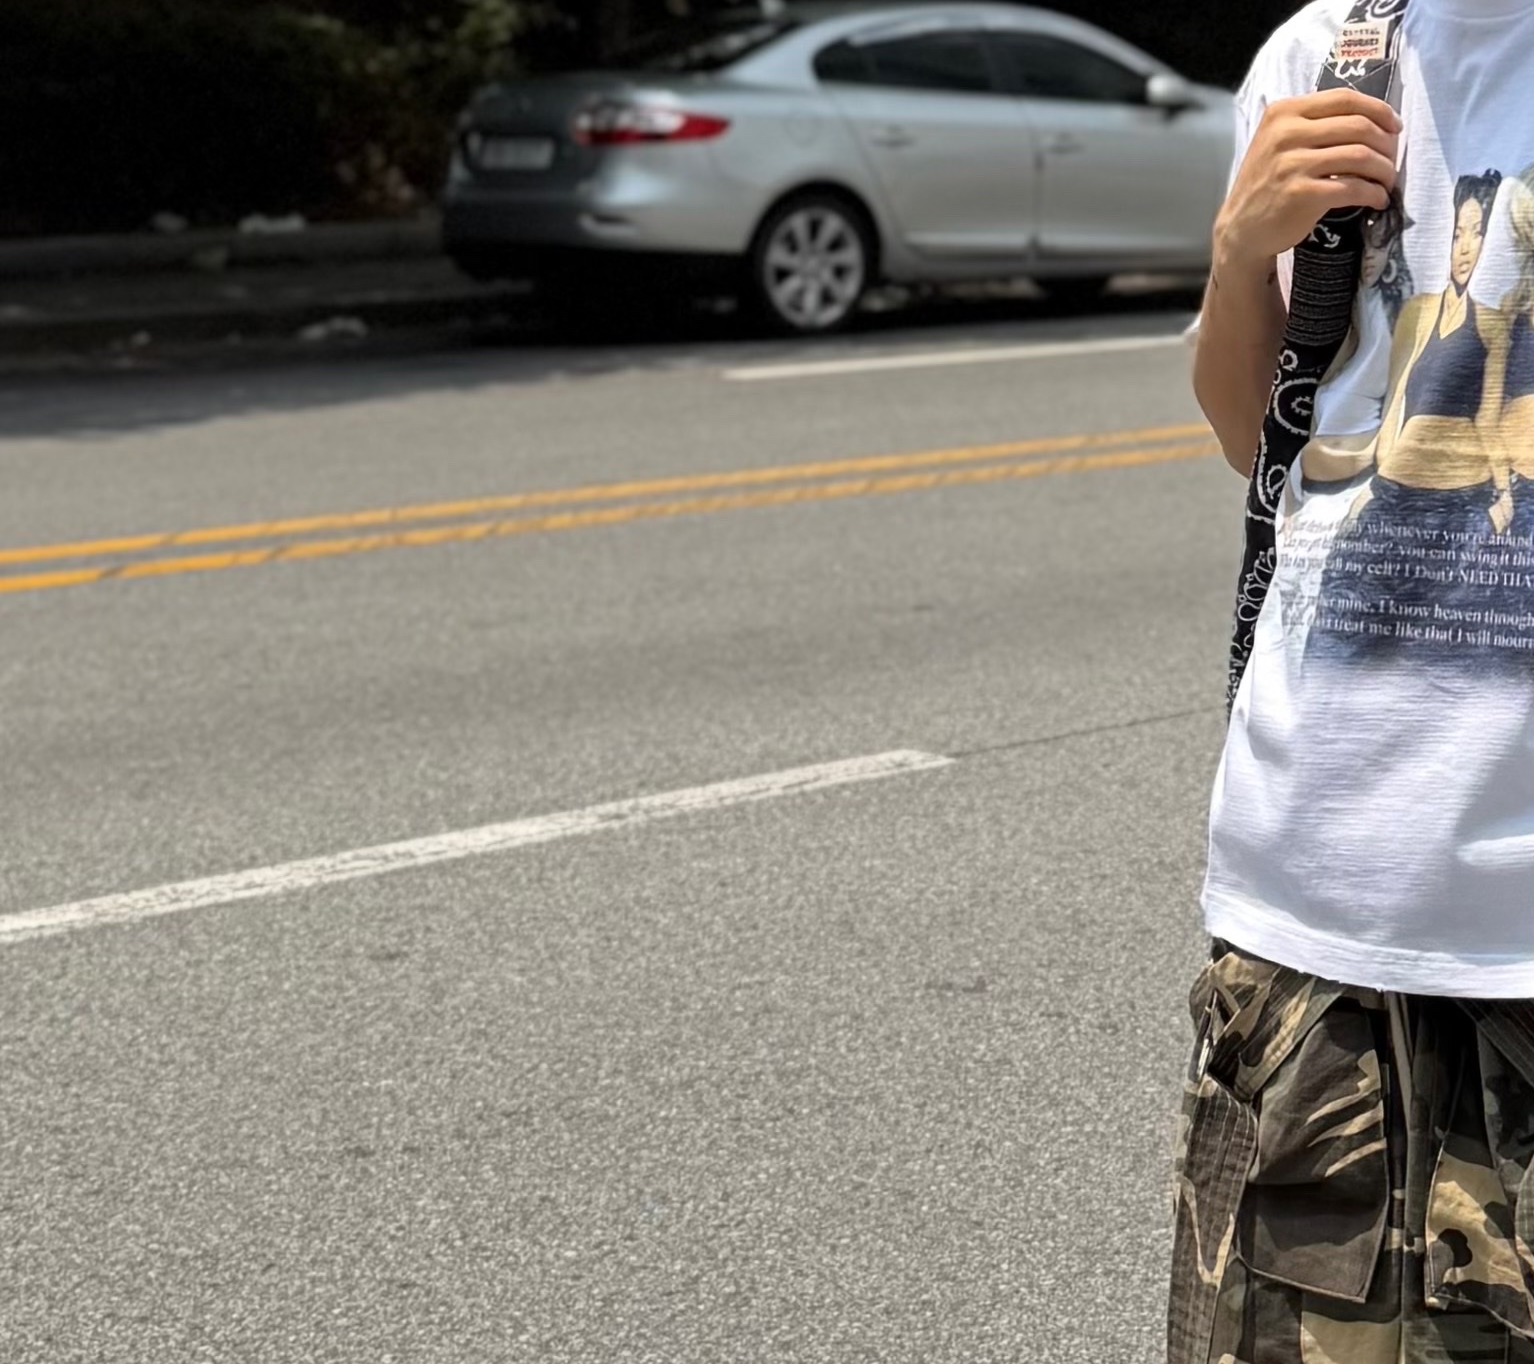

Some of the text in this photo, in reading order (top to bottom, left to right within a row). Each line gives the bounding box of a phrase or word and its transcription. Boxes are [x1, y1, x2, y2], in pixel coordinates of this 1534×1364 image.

[1366, 520, 1439, 541] whenever
[1398, 544, 1426, 560] you
[1429, 547, 1456, 561] can
[1459, 548, 1498, 569] swing
[1345, 560, 1364, 577] my
[1457, 568, 1499, 586] NEED
[1388, 599, 1432, 617] know
[1433, 602, 1482, 623] heaven
[1333, 617, 1365, 635] treat
[1368, 621, 1393, 637] me
[1395, 620, 1424, 640] like
[1424, 624, 1453, 643] that
[1465, 629, 1491, 646] will
